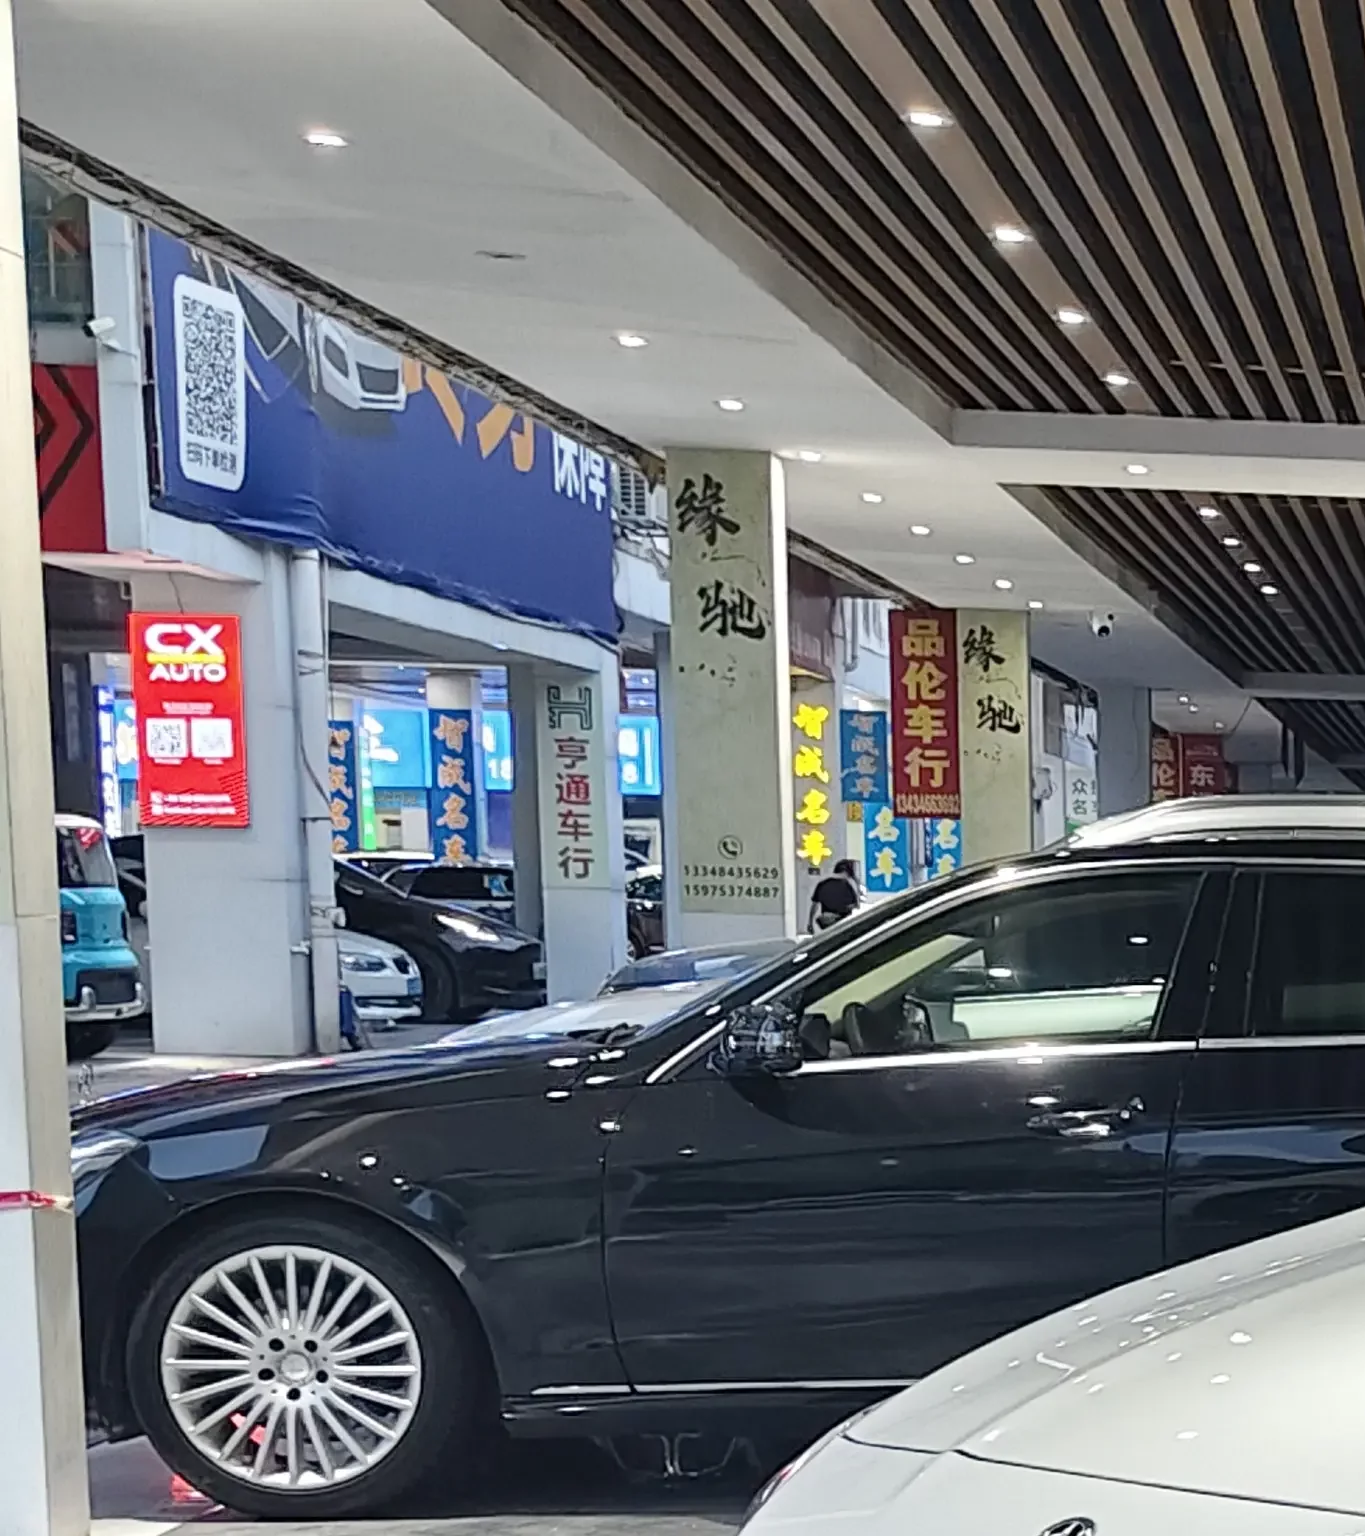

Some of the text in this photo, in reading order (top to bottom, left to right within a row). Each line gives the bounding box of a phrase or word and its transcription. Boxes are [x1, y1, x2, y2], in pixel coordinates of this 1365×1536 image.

[675, 473, 766, 640] 缘驰
[144, 623, 223, 655] CX
[149, 663, 226, 683] AUTO
[962, 625, 1021, 735] 缘驰
[901, 618, 950, 788] 品伦车行
[684, 864, 779, 880] 13348435629
[684, 884, 780, 898] 15975374887
